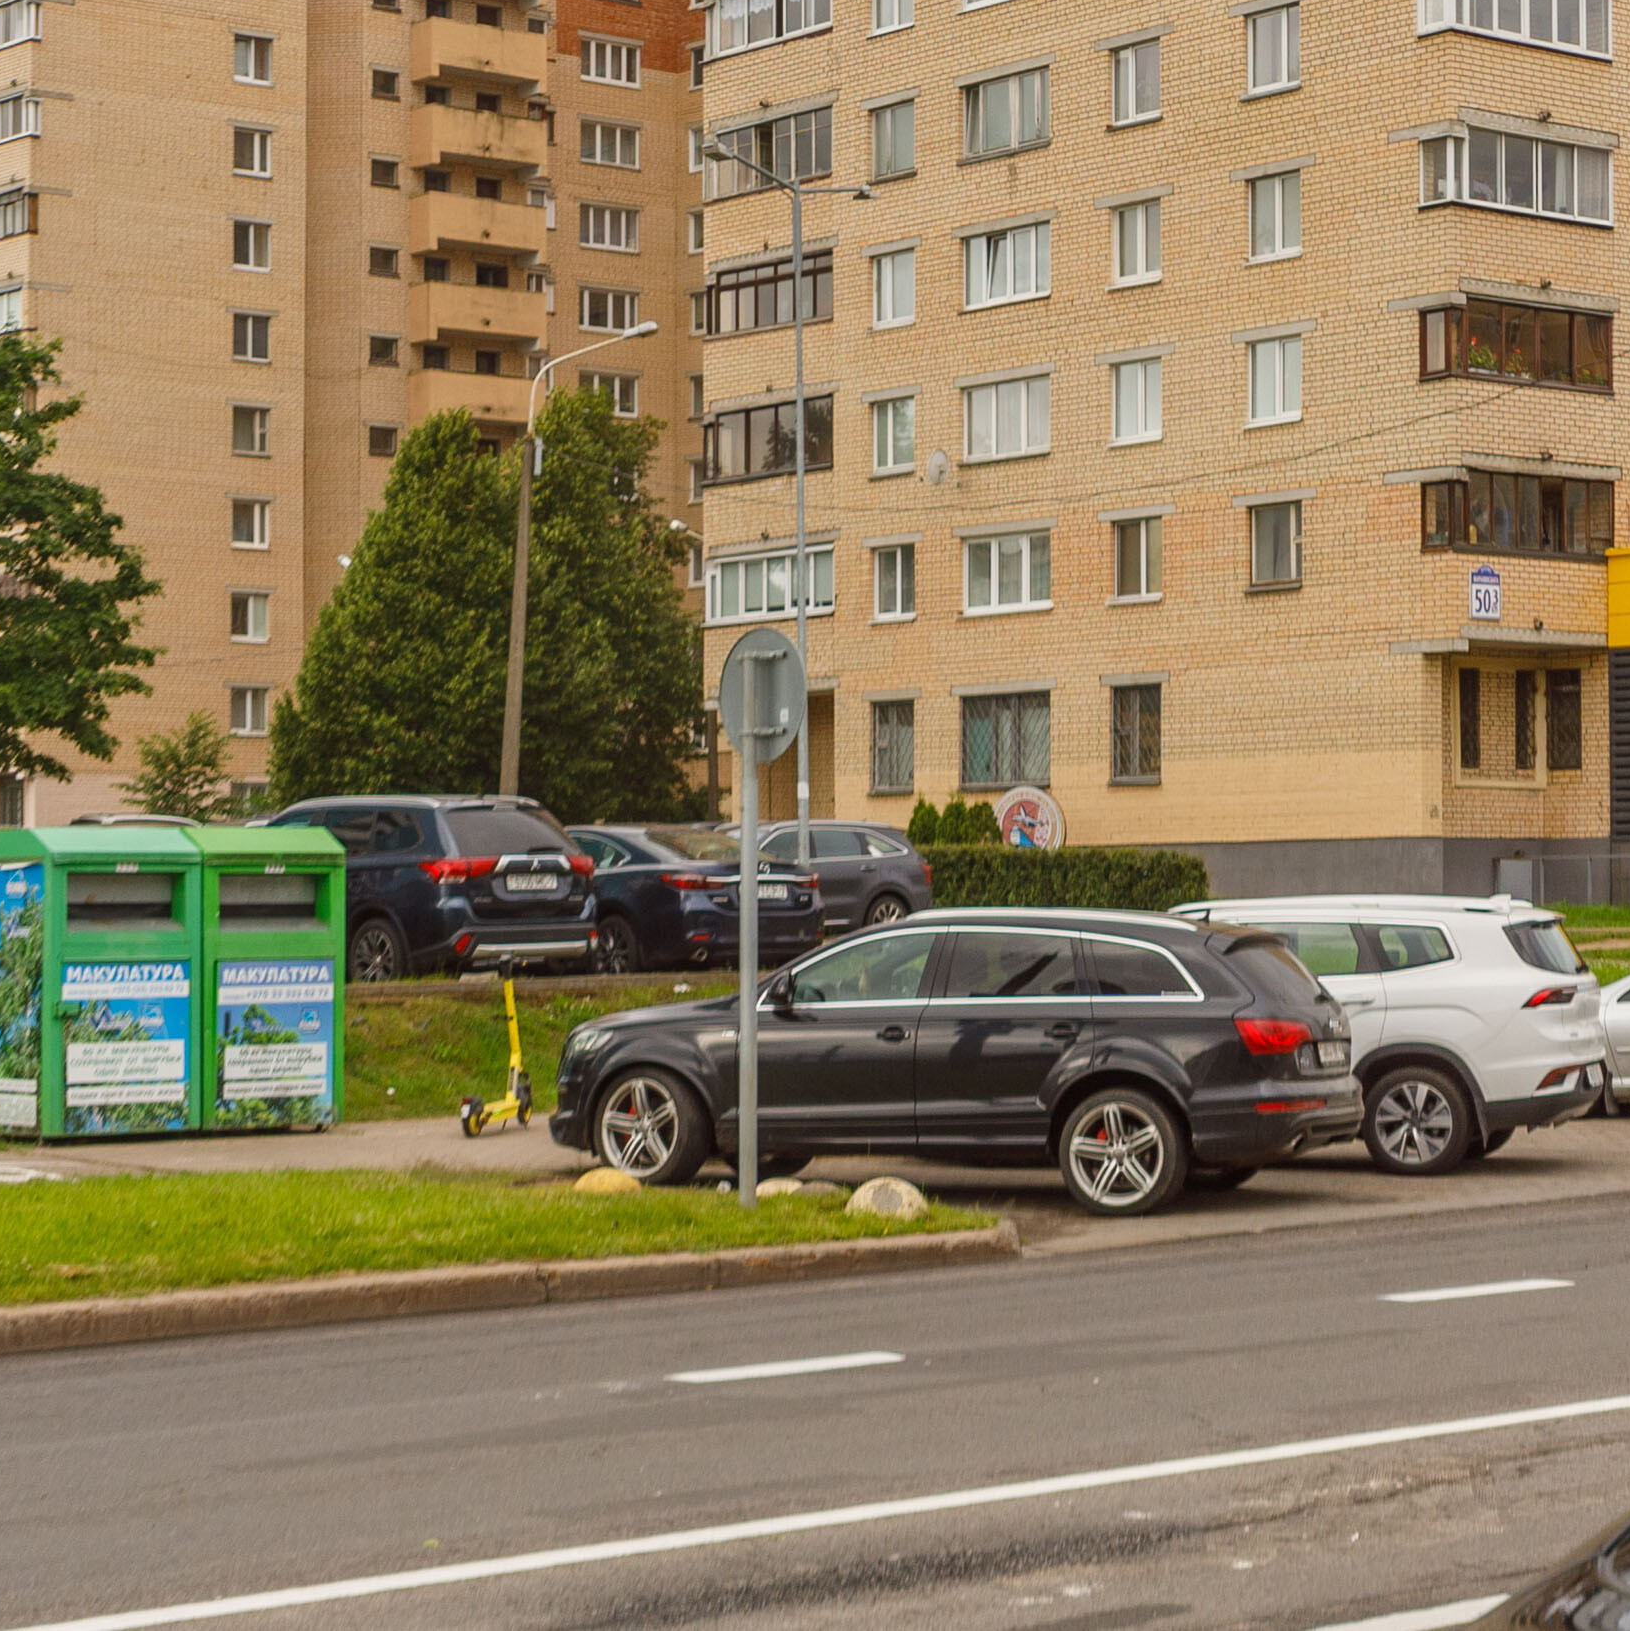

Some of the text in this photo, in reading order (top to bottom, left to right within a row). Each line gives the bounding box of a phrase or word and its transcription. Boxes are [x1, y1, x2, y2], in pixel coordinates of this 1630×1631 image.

[1475, 588, 1491, 614] 50
[66, 963, 186, 983] МАКУЛАТУРА
[223, 966, 329, 984] МАКУЛАТУРА
